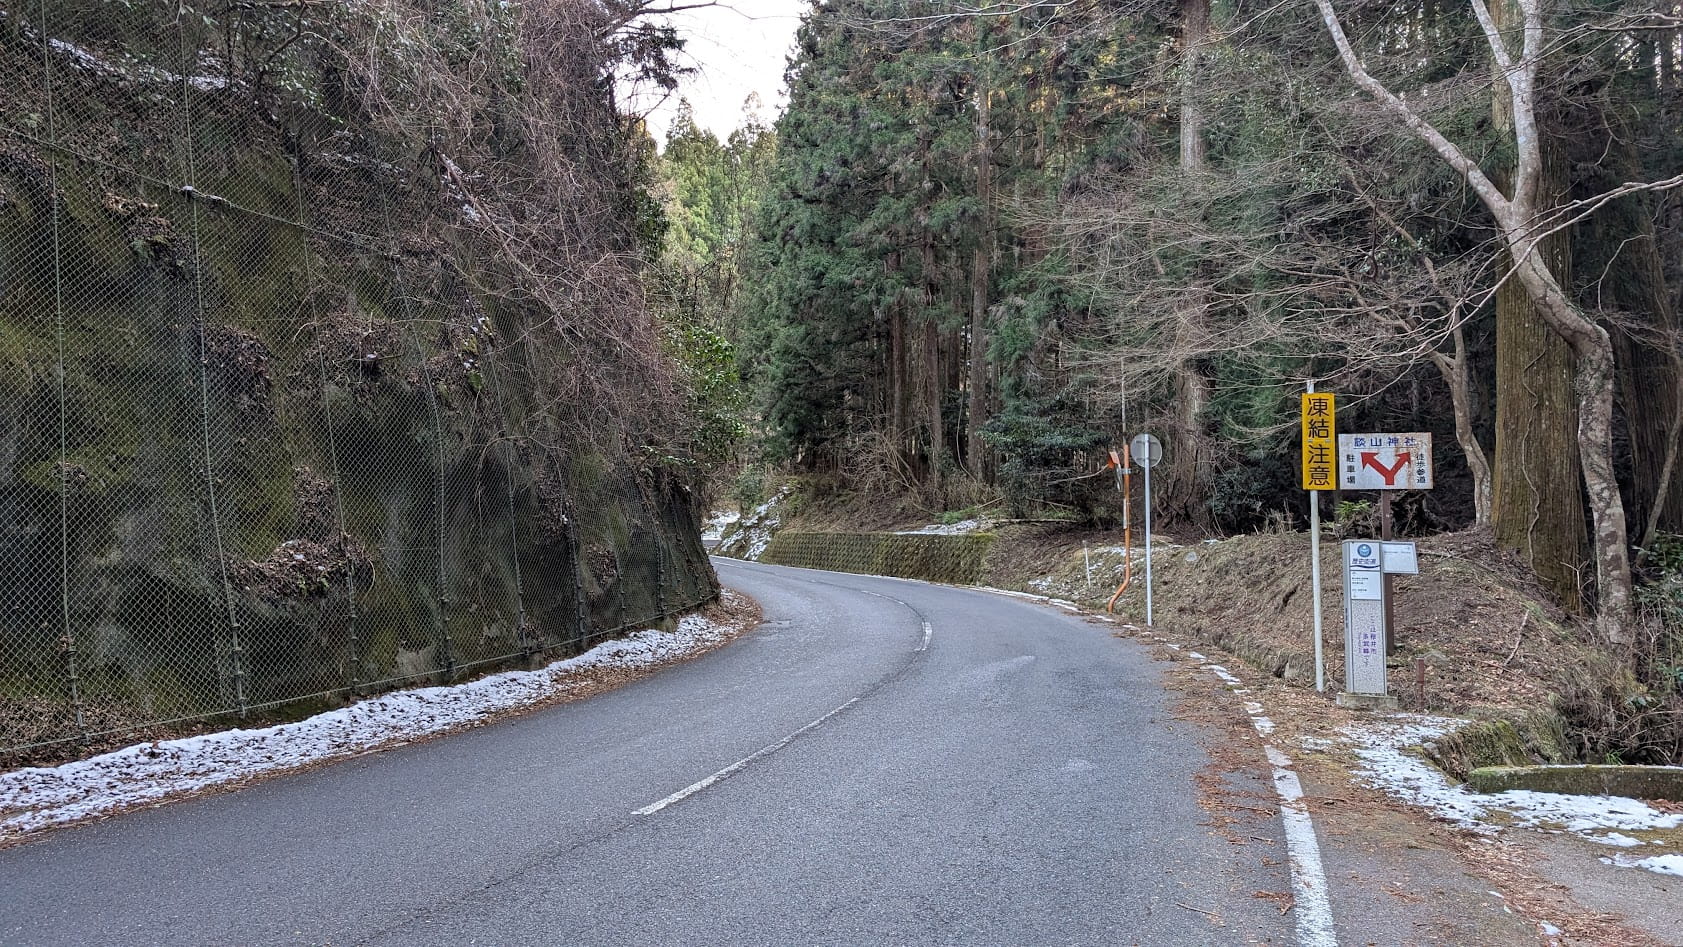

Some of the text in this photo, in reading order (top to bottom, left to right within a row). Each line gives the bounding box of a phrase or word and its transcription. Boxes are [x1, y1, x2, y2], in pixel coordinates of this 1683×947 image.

[1307, 398, 1330, 486] 凍結注意
[1354, 436, 1416, 447] 談山神社
[1346, 454, 1356, 484] 駐車場
[1416, 453, 1426, 484] 徒歩参道
